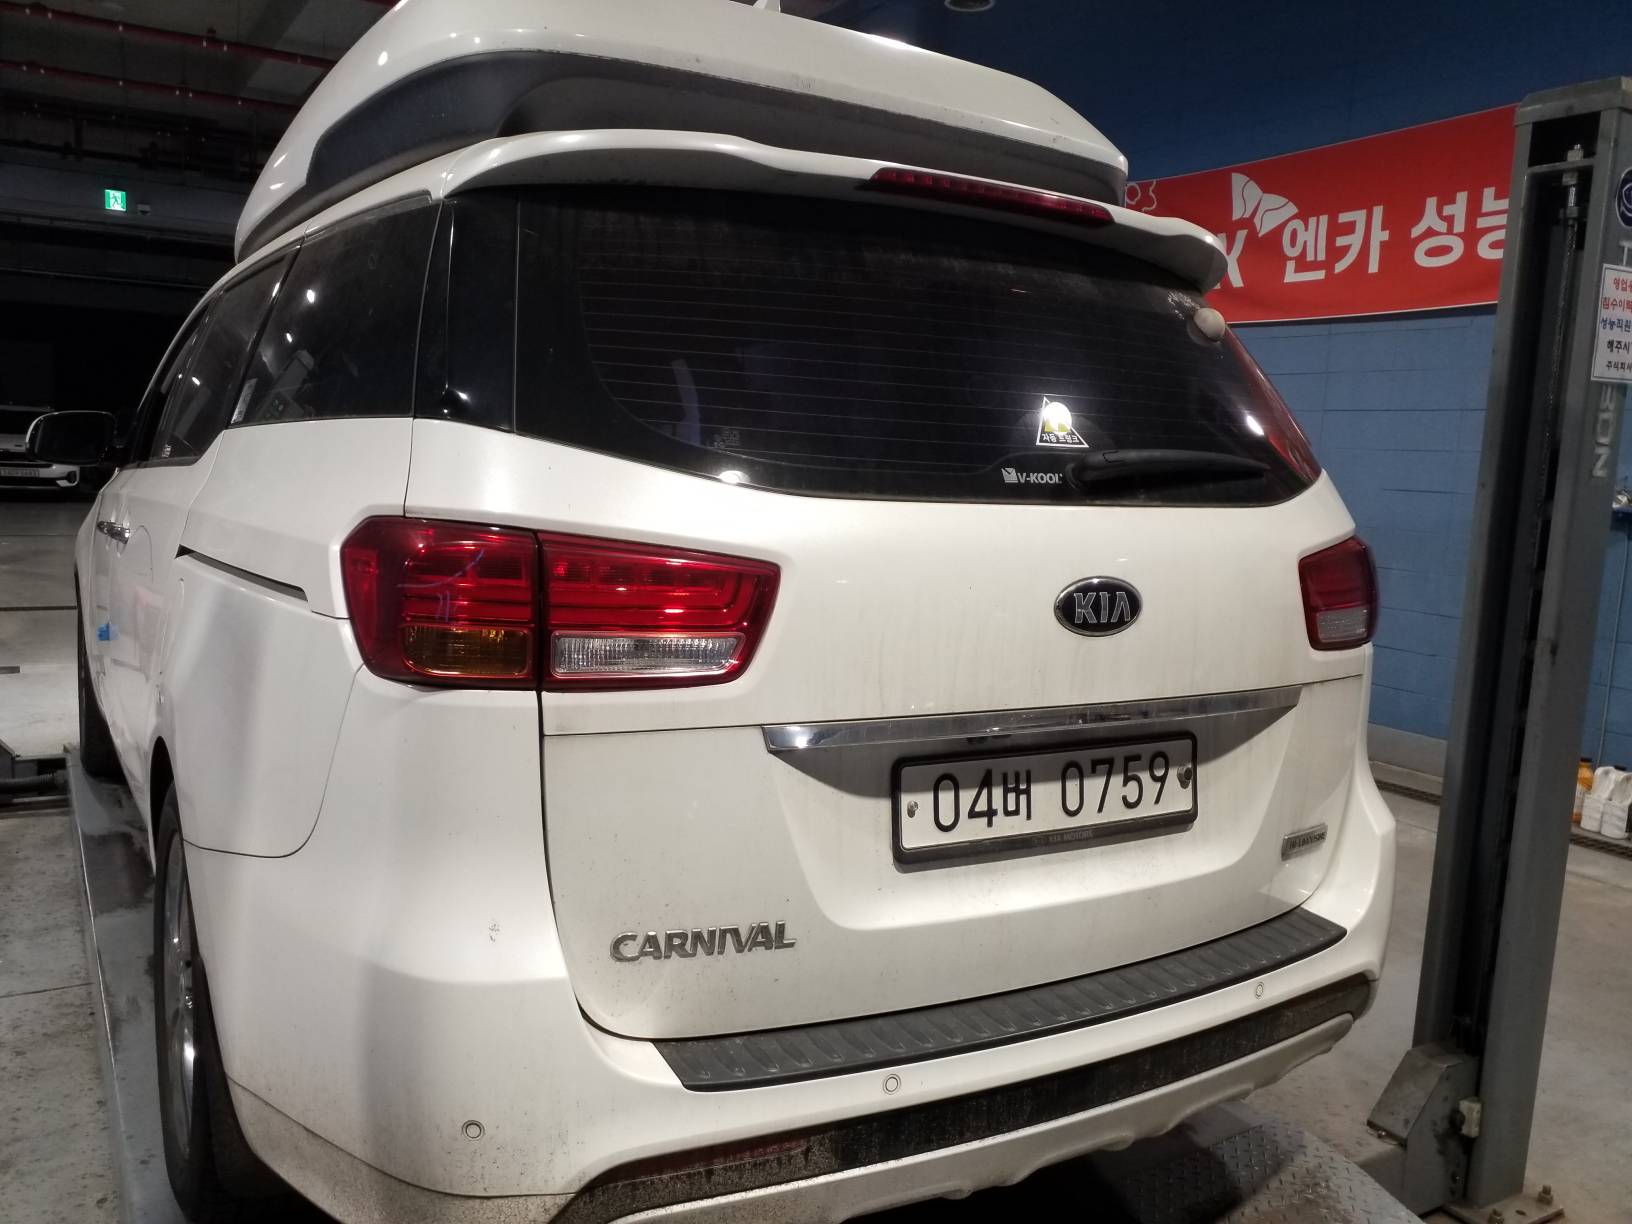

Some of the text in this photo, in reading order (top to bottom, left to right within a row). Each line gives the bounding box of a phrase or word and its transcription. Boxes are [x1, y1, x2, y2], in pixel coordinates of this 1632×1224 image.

[1213, 230, 1247, 288] K
[1282, 205, 1389, 283] 엔카
[1017, 472, 1063, 484] V-KOOL
[1073, 591, 1131, 623] KIA
[932, 751, 1170, 833] 04버 0759
[609, 920, 797, 962] CARNIVAL
